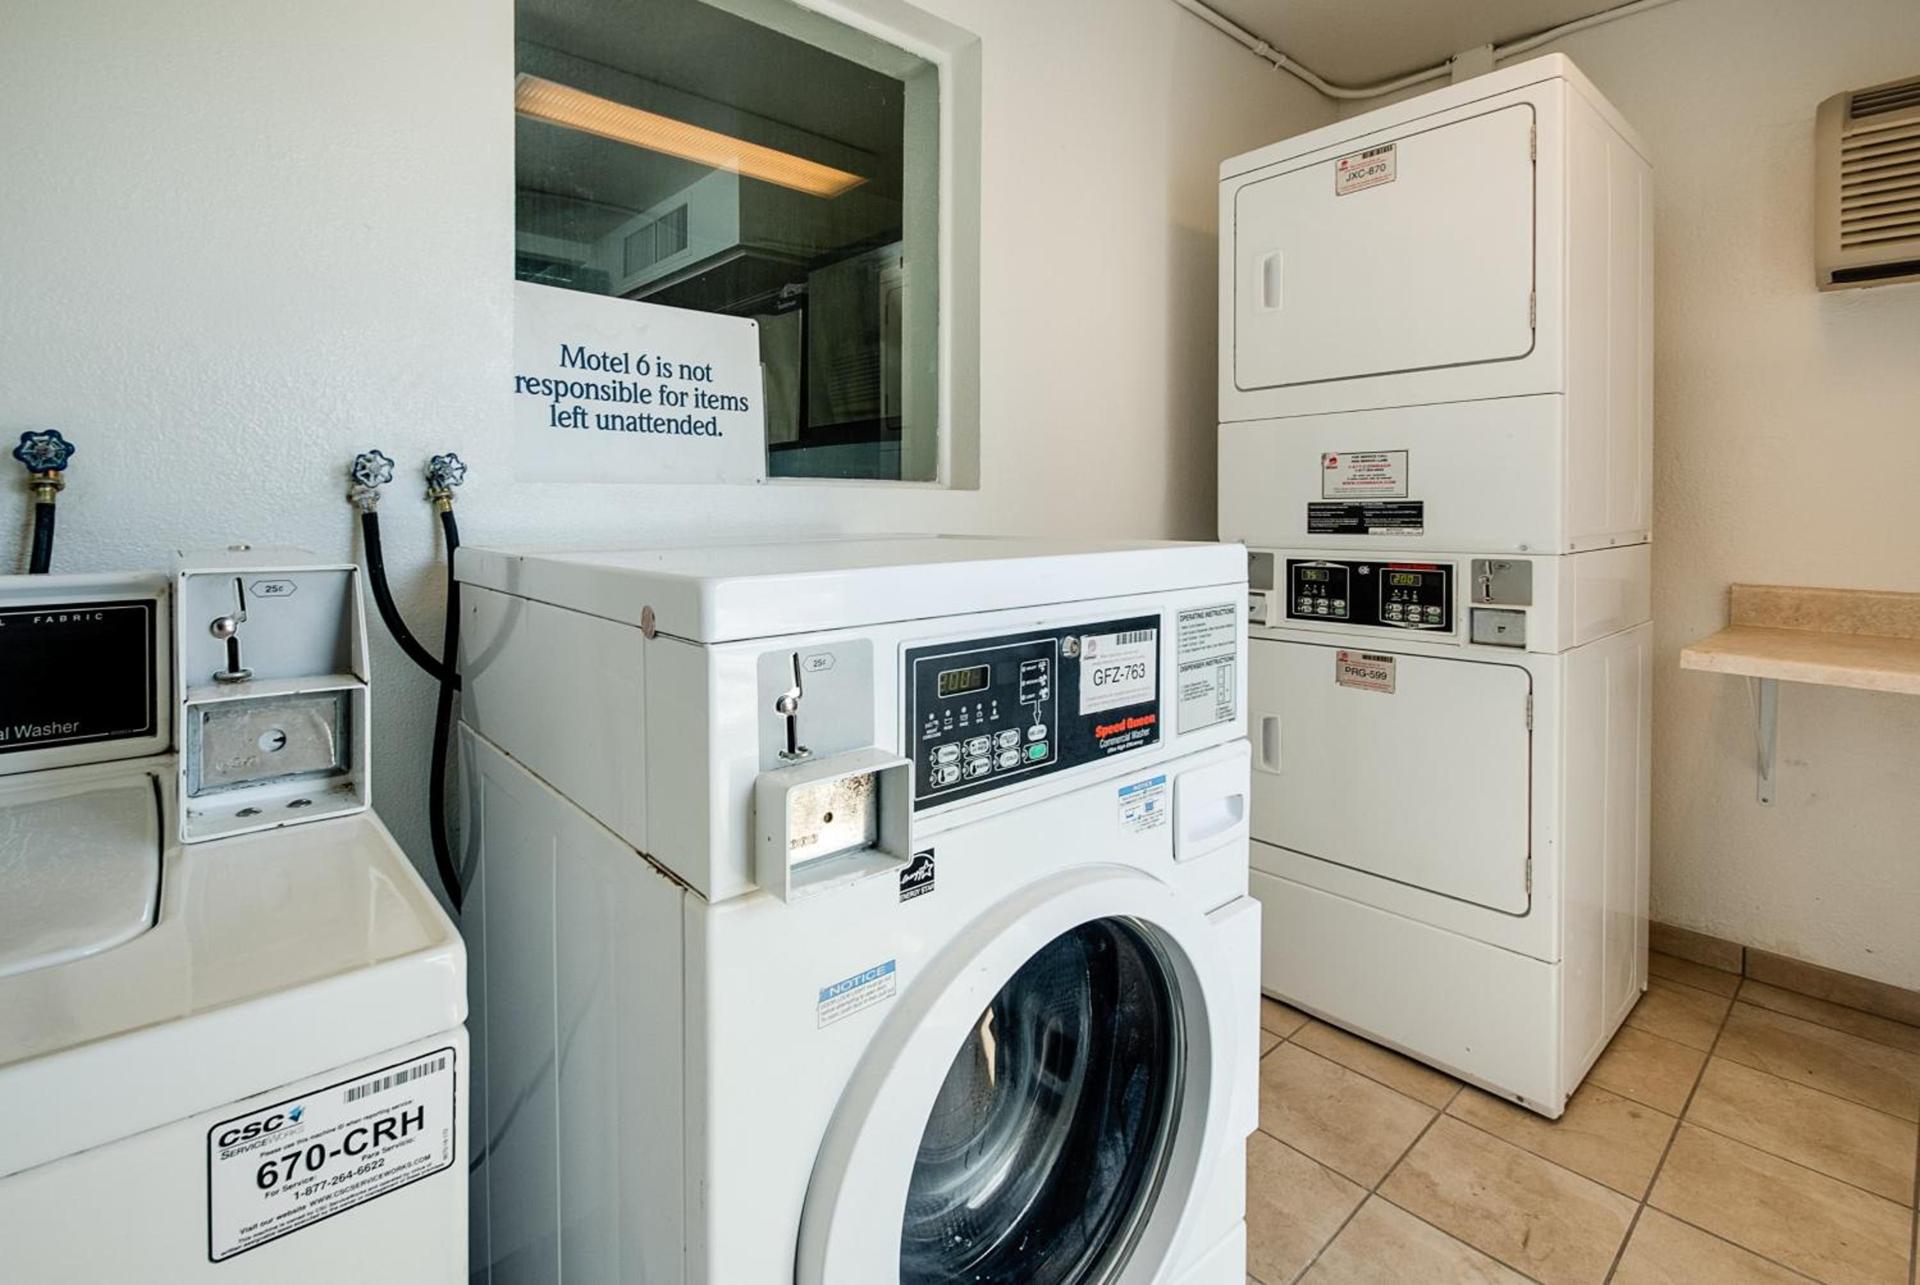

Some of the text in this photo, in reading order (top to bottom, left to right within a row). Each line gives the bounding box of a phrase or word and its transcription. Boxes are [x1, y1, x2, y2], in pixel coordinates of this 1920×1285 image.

[560, 343, 713, 383] Motel 6 is not
[515, 374, 749, 412] responsible for items
[550, 404, 723, 437] left unattended.
[33, 612, 104, 624] FABRIC
[1093, 662, 1146, 687] GFZ-763
[14, 721, 80, 739] Washer
[1095, 718, 1126, 739] Speed
[829, 966, 887, 997] NOTICE
[218, 1112, 284, 1148] CSC
[256, 1104, 423, 1193] 670-CRH
[265, 1187, 279, 1198] For
[294, 1157, 384, 1200] 1-877-264-6622
[259, 1217, 273, 1227] our
